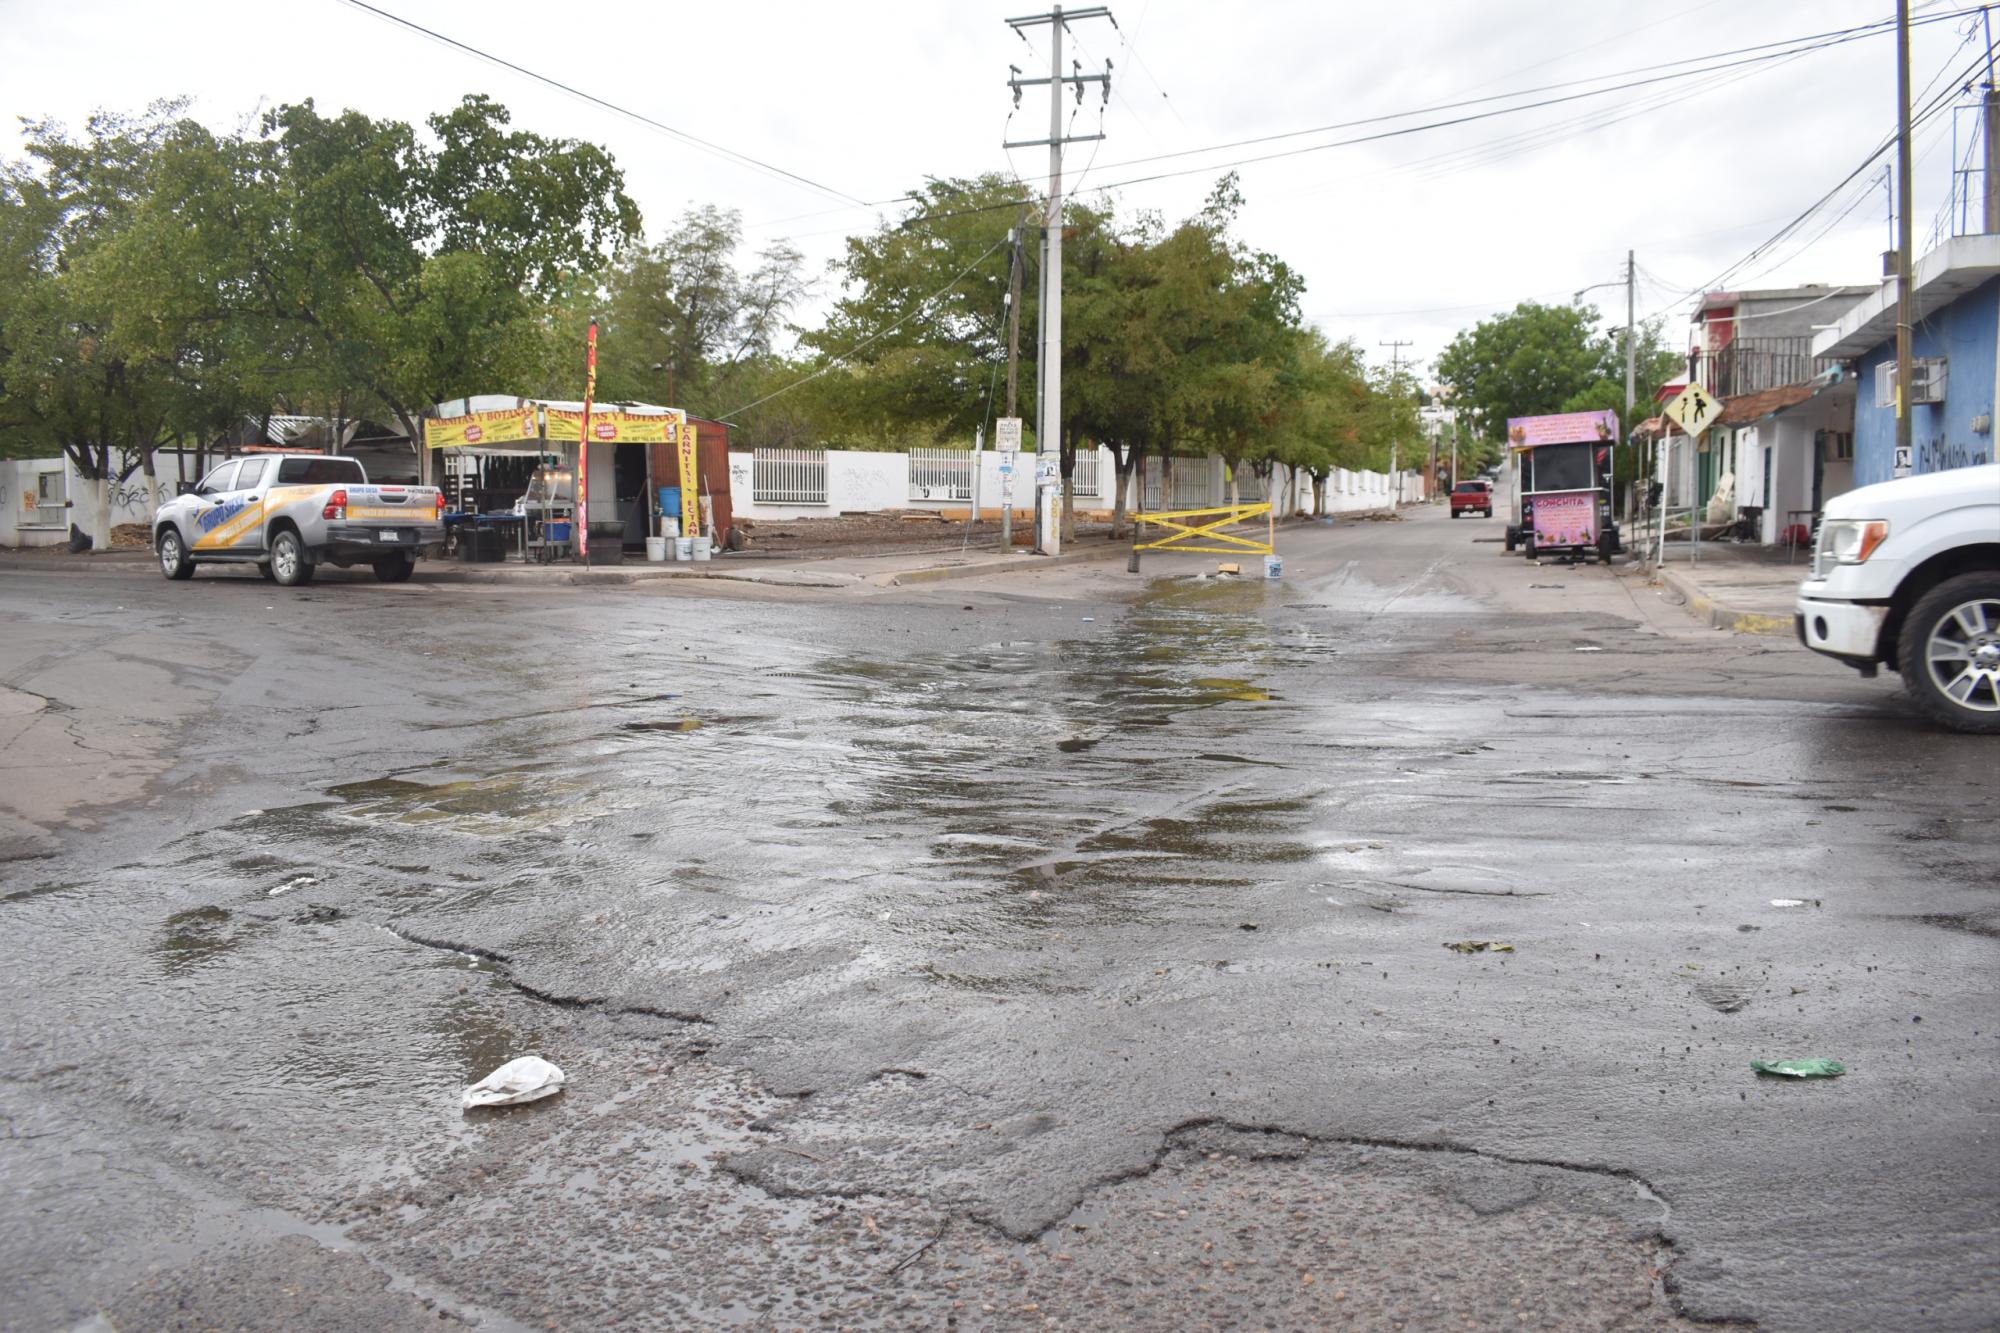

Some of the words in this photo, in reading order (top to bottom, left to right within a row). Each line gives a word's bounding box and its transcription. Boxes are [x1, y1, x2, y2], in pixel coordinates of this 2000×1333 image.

[428, 413, 475, 427] CARNITAS
[477, 412, 485, 422] Y
[612, 412, 620, 421] Y
[623, 413, 678, 422] BOTANAS
[1536, 498, 1584, 507] CONCHITA
